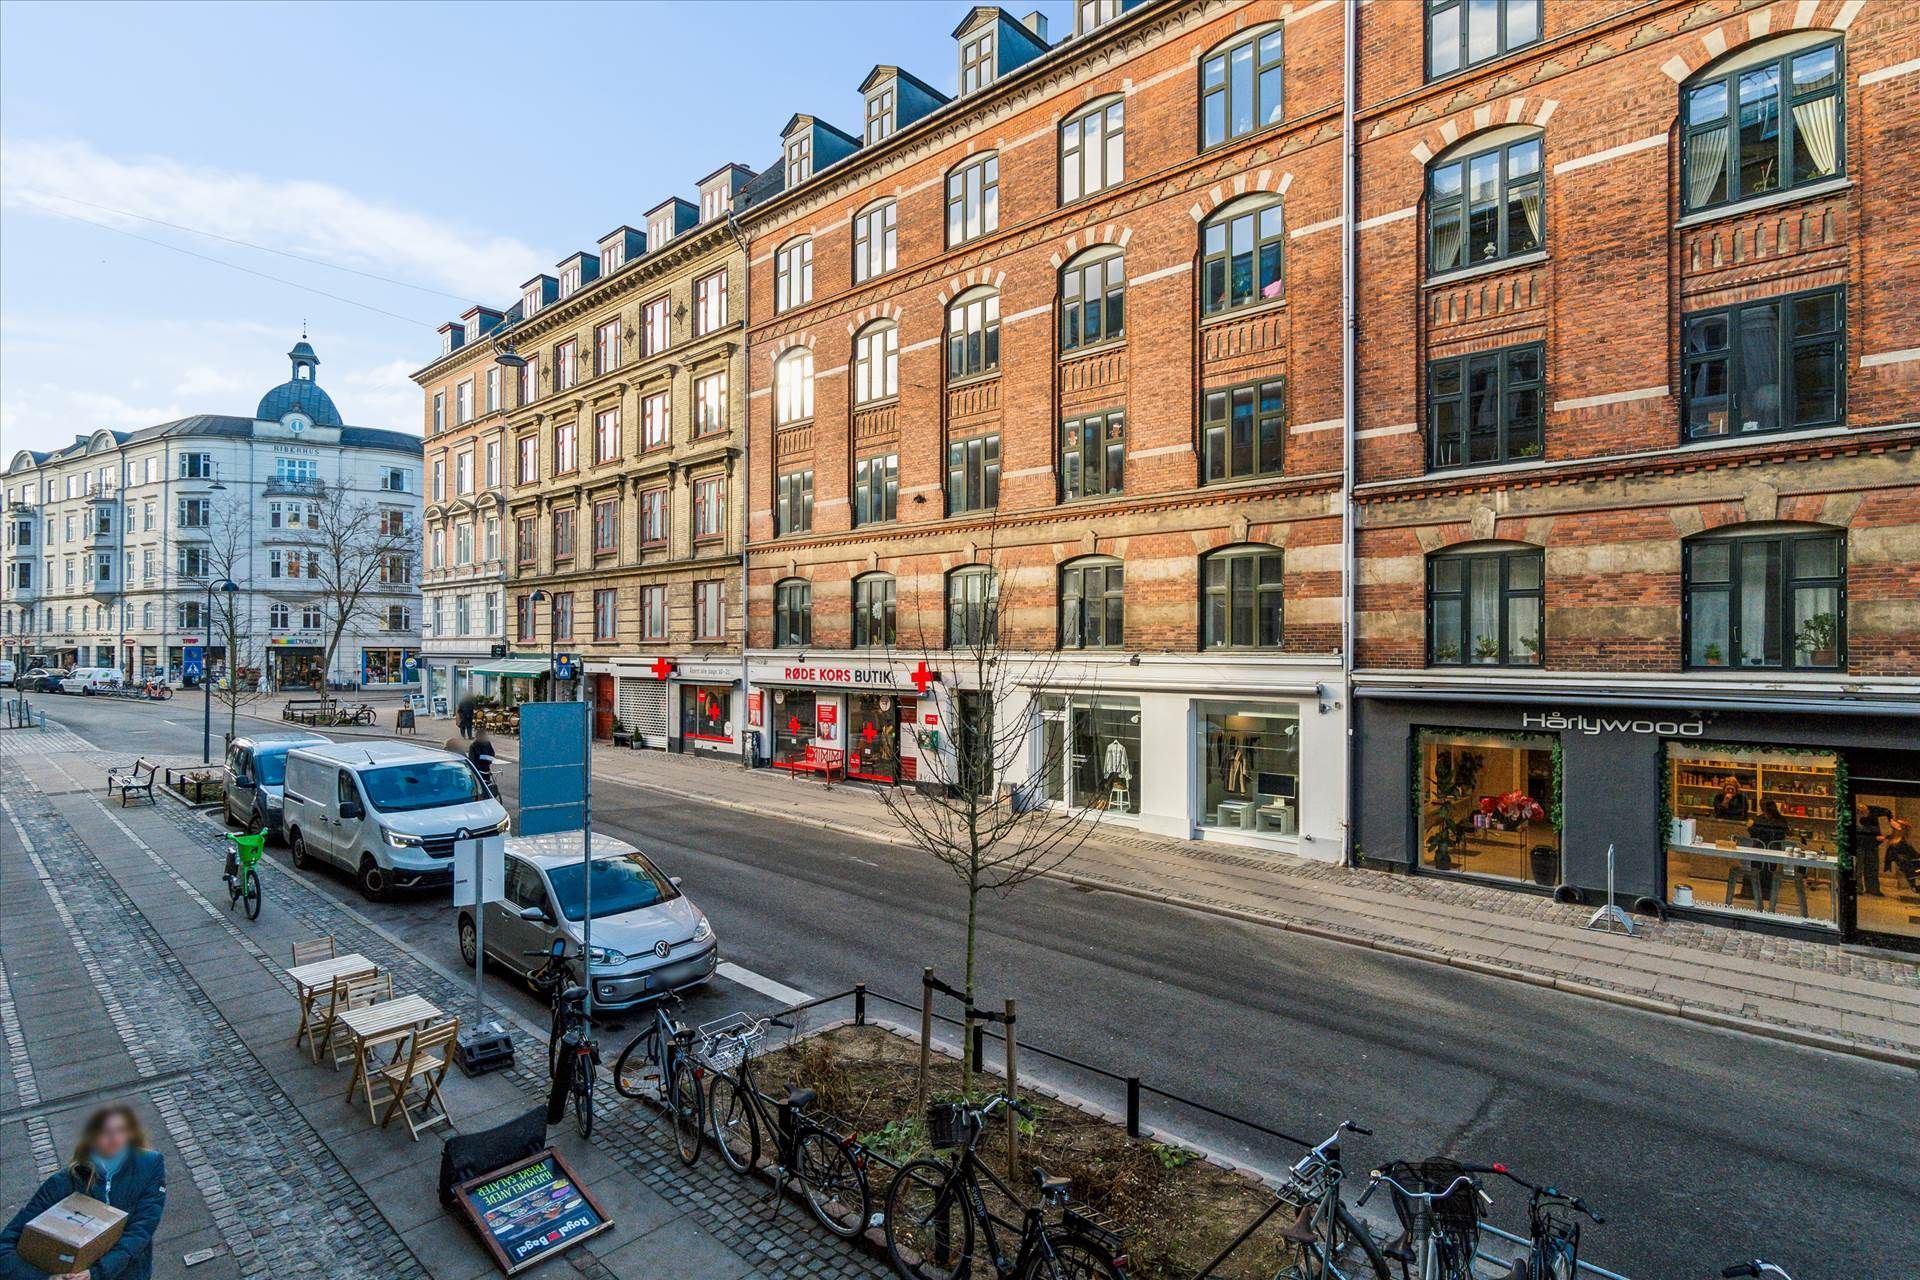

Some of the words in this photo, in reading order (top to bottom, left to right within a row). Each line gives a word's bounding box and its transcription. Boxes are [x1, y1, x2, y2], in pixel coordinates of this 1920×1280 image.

[785, 668, 815, 681] RØDE
[819, 669, 851, 682] KORS
[855, 670, 892, 684] BUTIK
[1523, 711, 1703, 736] Hårlywood
[515, 1162, 548, 1183] FRISKE
[477, 1175, 516, 1197] SALATER
[483, 1171, 554, 1206] HJEMMELAVEDE
[559, 1216, 590, 1237] Royal
[516, 1236, 550, 1257] Bagel
